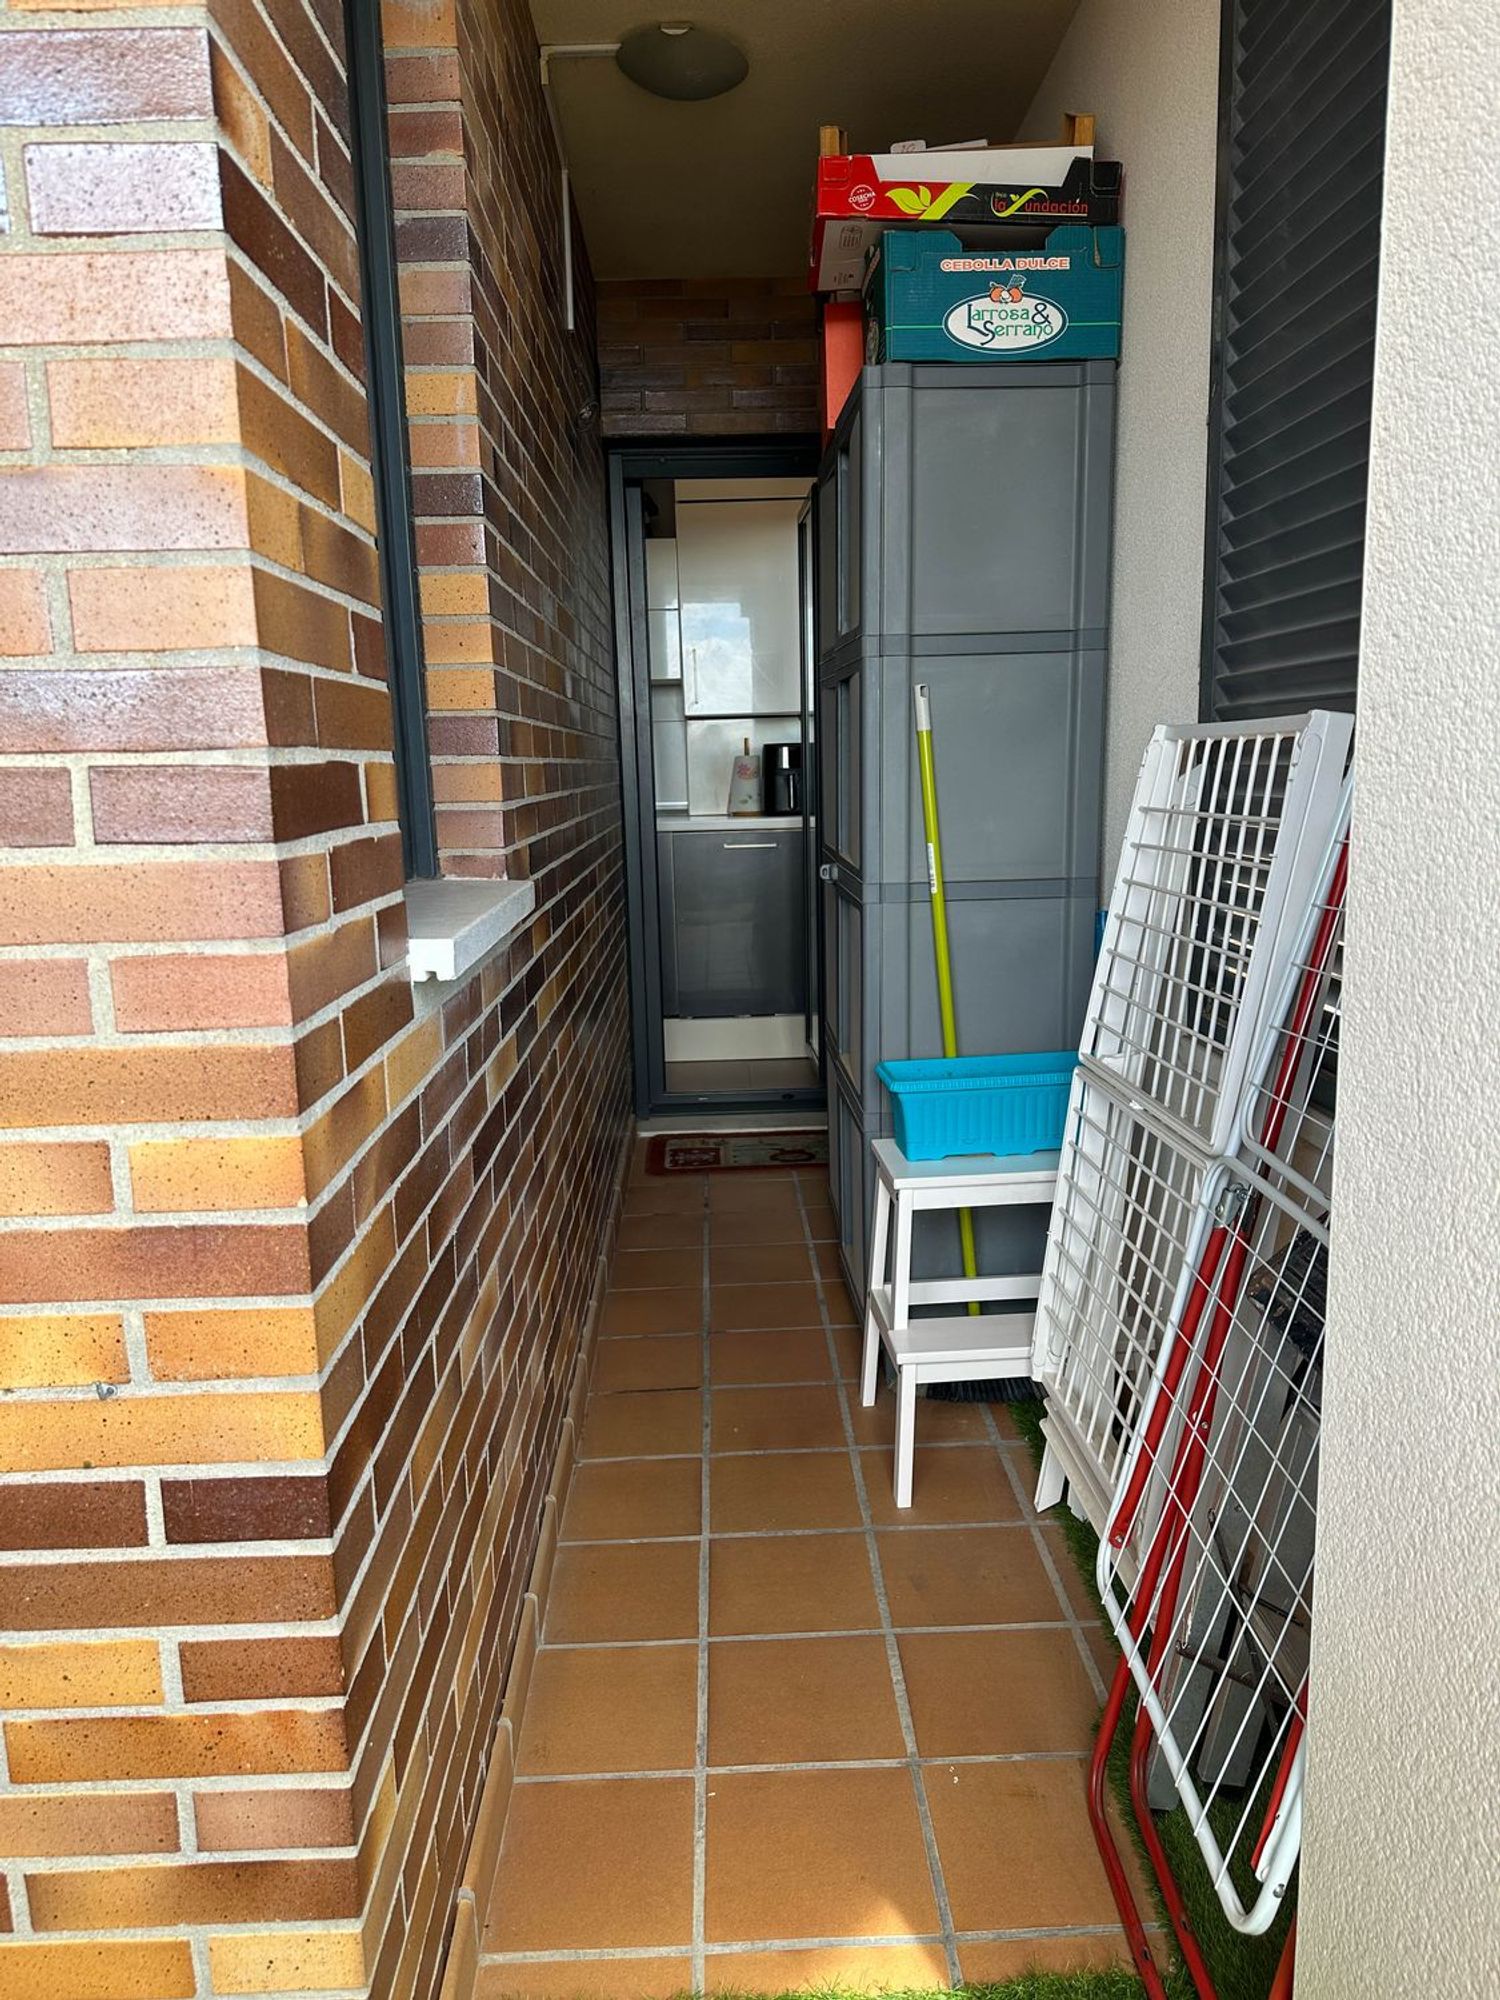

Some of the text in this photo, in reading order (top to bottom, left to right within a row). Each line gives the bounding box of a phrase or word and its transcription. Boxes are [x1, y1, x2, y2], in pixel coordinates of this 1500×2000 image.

[940, 257, 1070, 272] CEBOLLA DULCE
[967, 302, 1051, 337] Larrosa &
